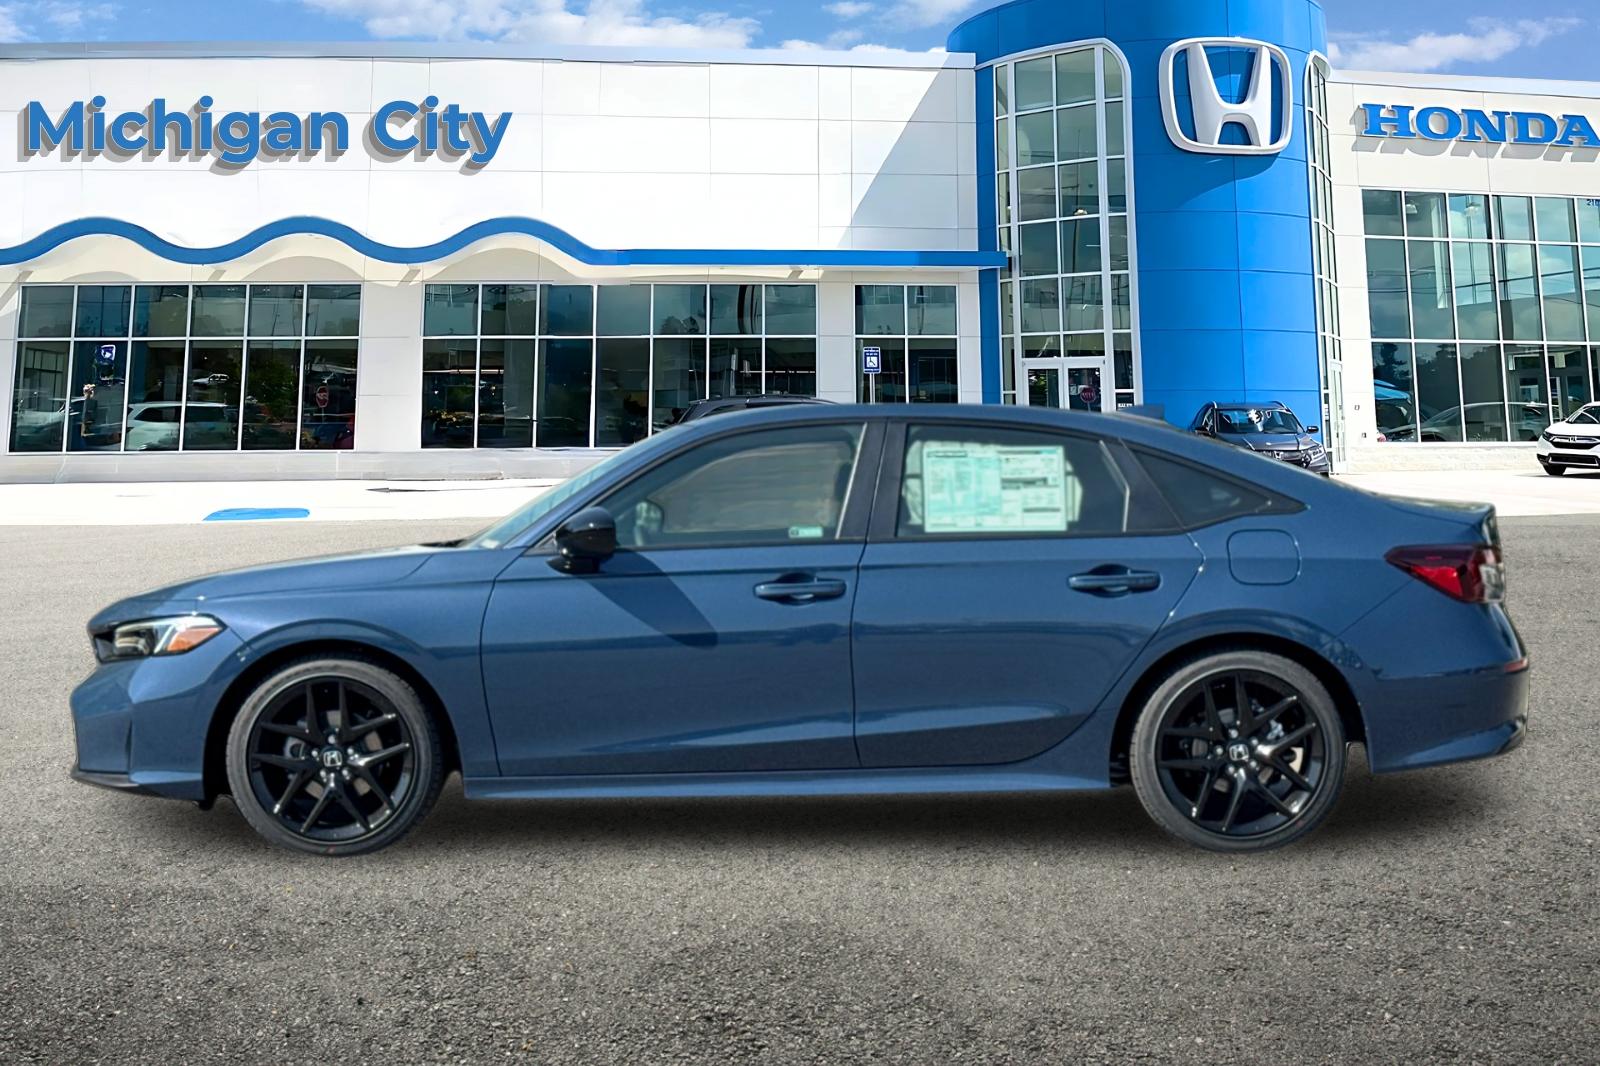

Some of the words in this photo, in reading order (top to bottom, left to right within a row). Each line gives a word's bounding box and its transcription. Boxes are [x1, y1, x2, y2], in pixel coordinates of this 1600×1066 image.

[28, 94, 350, 164] Michigan
[373, 94, 514, 164] City
[1361, 102, 1600, 148] HONDA
